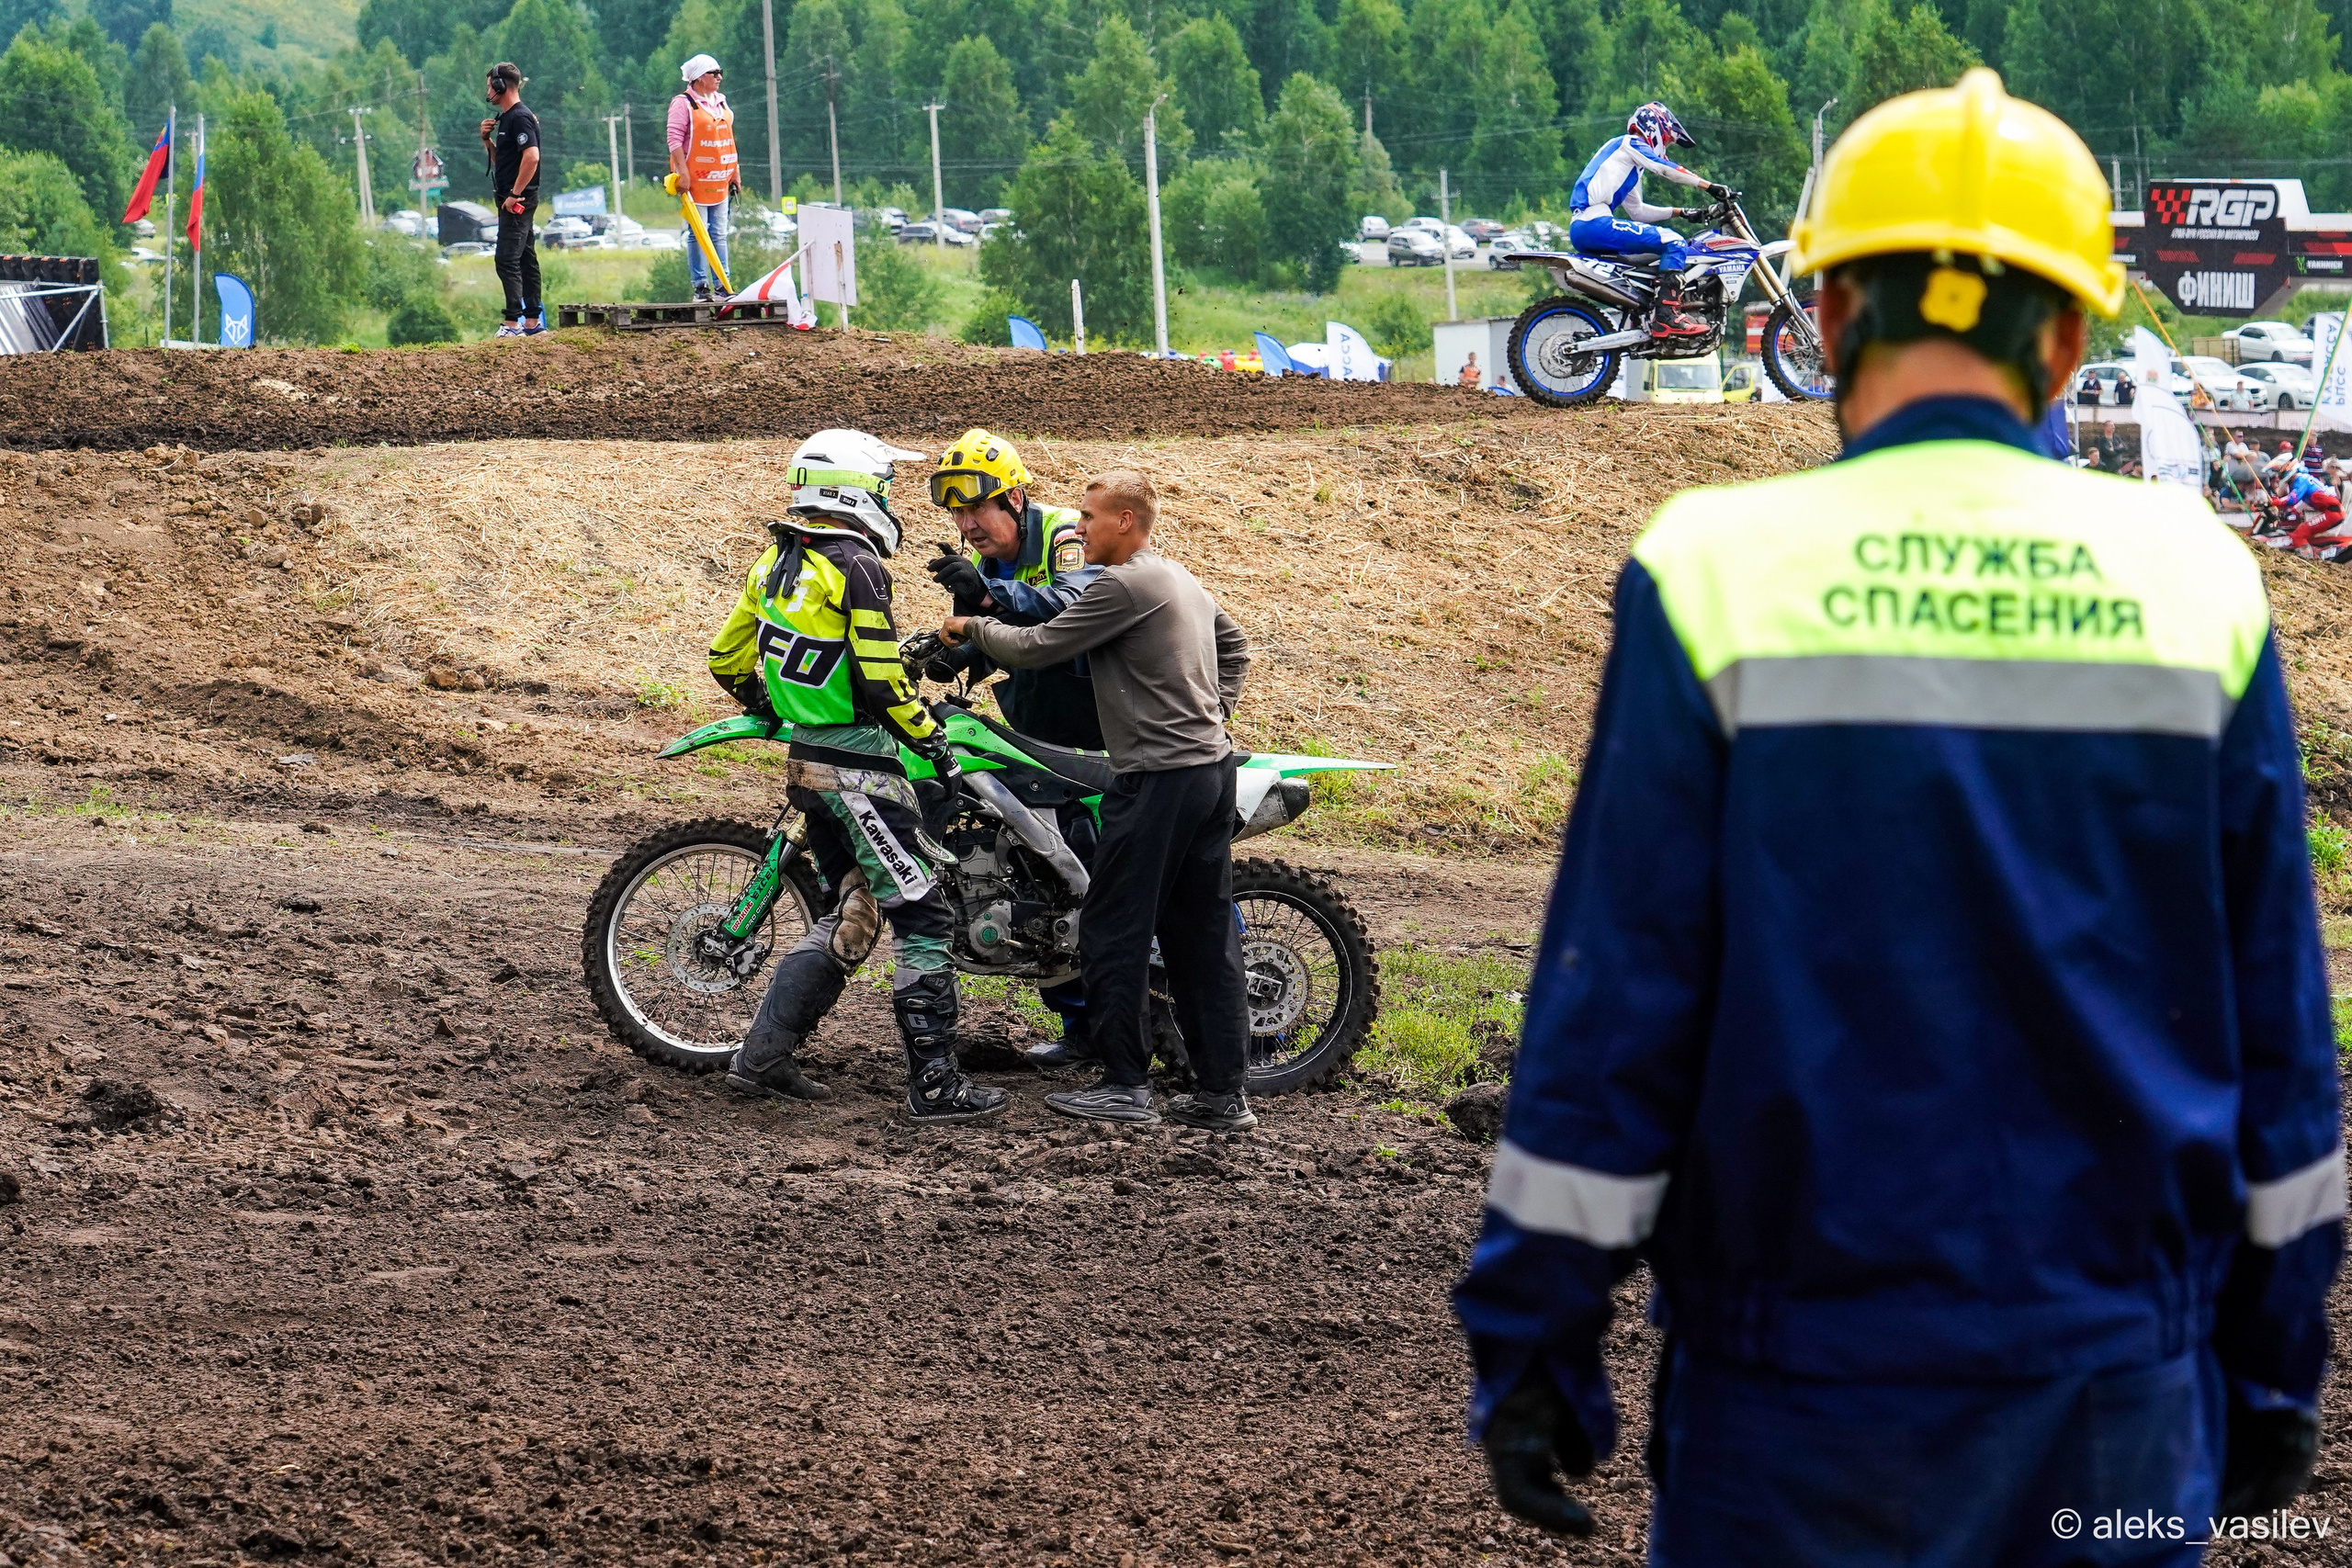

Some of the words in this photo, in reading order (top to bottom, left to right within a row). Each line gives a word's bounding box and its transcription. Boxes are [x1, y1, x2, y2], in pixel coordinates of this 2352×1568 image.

[2186, 188, 2277, 227] RGP
[1718, 264, 1746, 274] YAMAHA
[2177, 271, 2256, 309] ФИНИШ
[1854, 533, 2102, 581] СЛУЖБА
[1824, 586, 2143, 637] СПАСЕНИЯ
[755, 615, 846, 689] FO
[859, 810, 918, 886] Kawasaki
[752, 866, 777, 900] EXCEL
[731, 900, 754, 932] BRAKING
[744, 914, 757, 931] PRO
[755, 885, 775, 915] CIRCUIT
